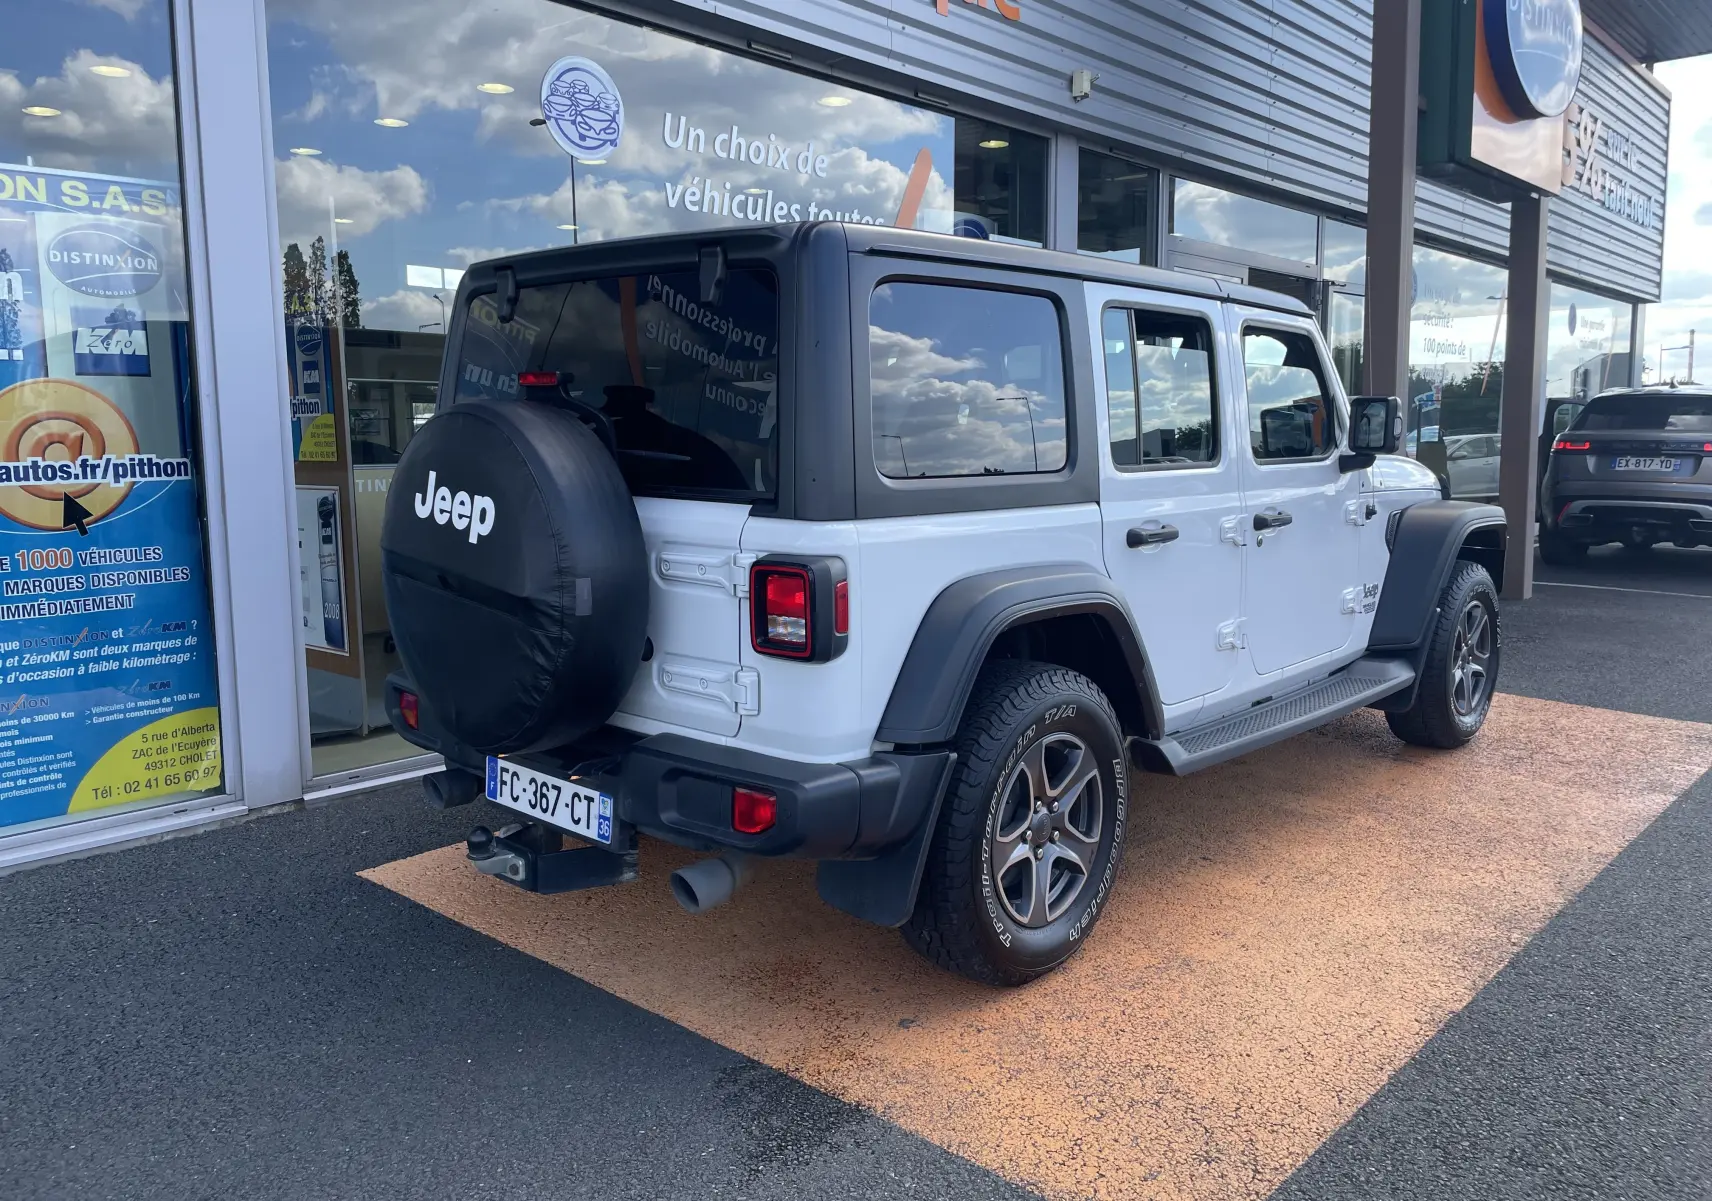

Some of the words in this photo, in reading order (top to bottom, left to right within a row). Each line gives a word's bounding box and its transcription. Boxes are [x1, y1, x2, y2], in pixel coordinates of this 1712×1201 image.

[663, 112, 705, 154] Un
[713, 125, 790, 171] choix
[797, 139, 828, 178] de
[665, 175, 800, 223] véhicules
[49, 250, 158, 270] DISTINXION
[80, 285, 137, 296] AUTOMOBILE
[414, 470, 495, 544] Jeep
[16, 549, 72, 570] 1000
[79, 546, 162, 566] VÉHICULES
[5, 576, 84, 595] MARQUES
[91, 567, 190, 588] DISPONIBLES
[0, 594, 134, 620] IMMÉDIATEMENT
[23, 629, 109, 649] DISTINXION
[112, 628, 124, 638] et
[191, 620, 197, 629] ?
[6, 656, 20, 667] et
[22, 650, 70, 666] ZéroKM
[73, 646, 98, 660] sont
[101, 644, 128, 656] deux
[132, 638, 181, 652] marques
[184, 635, 197, 645] de
[7, 666, 74, 683] d'occasion
[78, 664, 85, 675] à
[88, 660, 119, 674] faible
[137, 698, 160, 707] moins
[173, 694, 186, 702] 100
[188, 692, 200, 700] Km
[21, 717, 31, 725] de
[33, 713, 58, 722] 30000
[61, 711, 74, 719] Km
[93, 713, 123, 723] Garantie
[126, 706, 173, 718] constructeur
[14, 735, 53, 746] minimum
[141, 734, 148, 743] 5
[151, 732, 168, 742] rue
[171, 723, 215, 738] d'Alberta
[132, 748, 152, 759] ZAC
[156, 746, 168, 755] de
[171, 737, 216, 753] l'Ecuyère
[2, 766, 37, 778] contrôlés
[40, 763, 47, 771] et
[18, 755, 54, 766] Distinxion
[144, 758, 176, 771] 49312
[180, 750, 218, 765] CHOLET
[0, 785, 55, 800] professionnels
[92, 786, 112, 800] Tél
[124, 780, 140, 794] 02
[145, 777, 159, 789] 41
[164, 773, 180, 786] 65
[184, 770, 199, 782] 60
[203, 766, 216, 778] 97
[490, 781, 495, 790] F
[500, 766, 595, 830] FC-367-CT
[598, 818, 610, 836] 36
